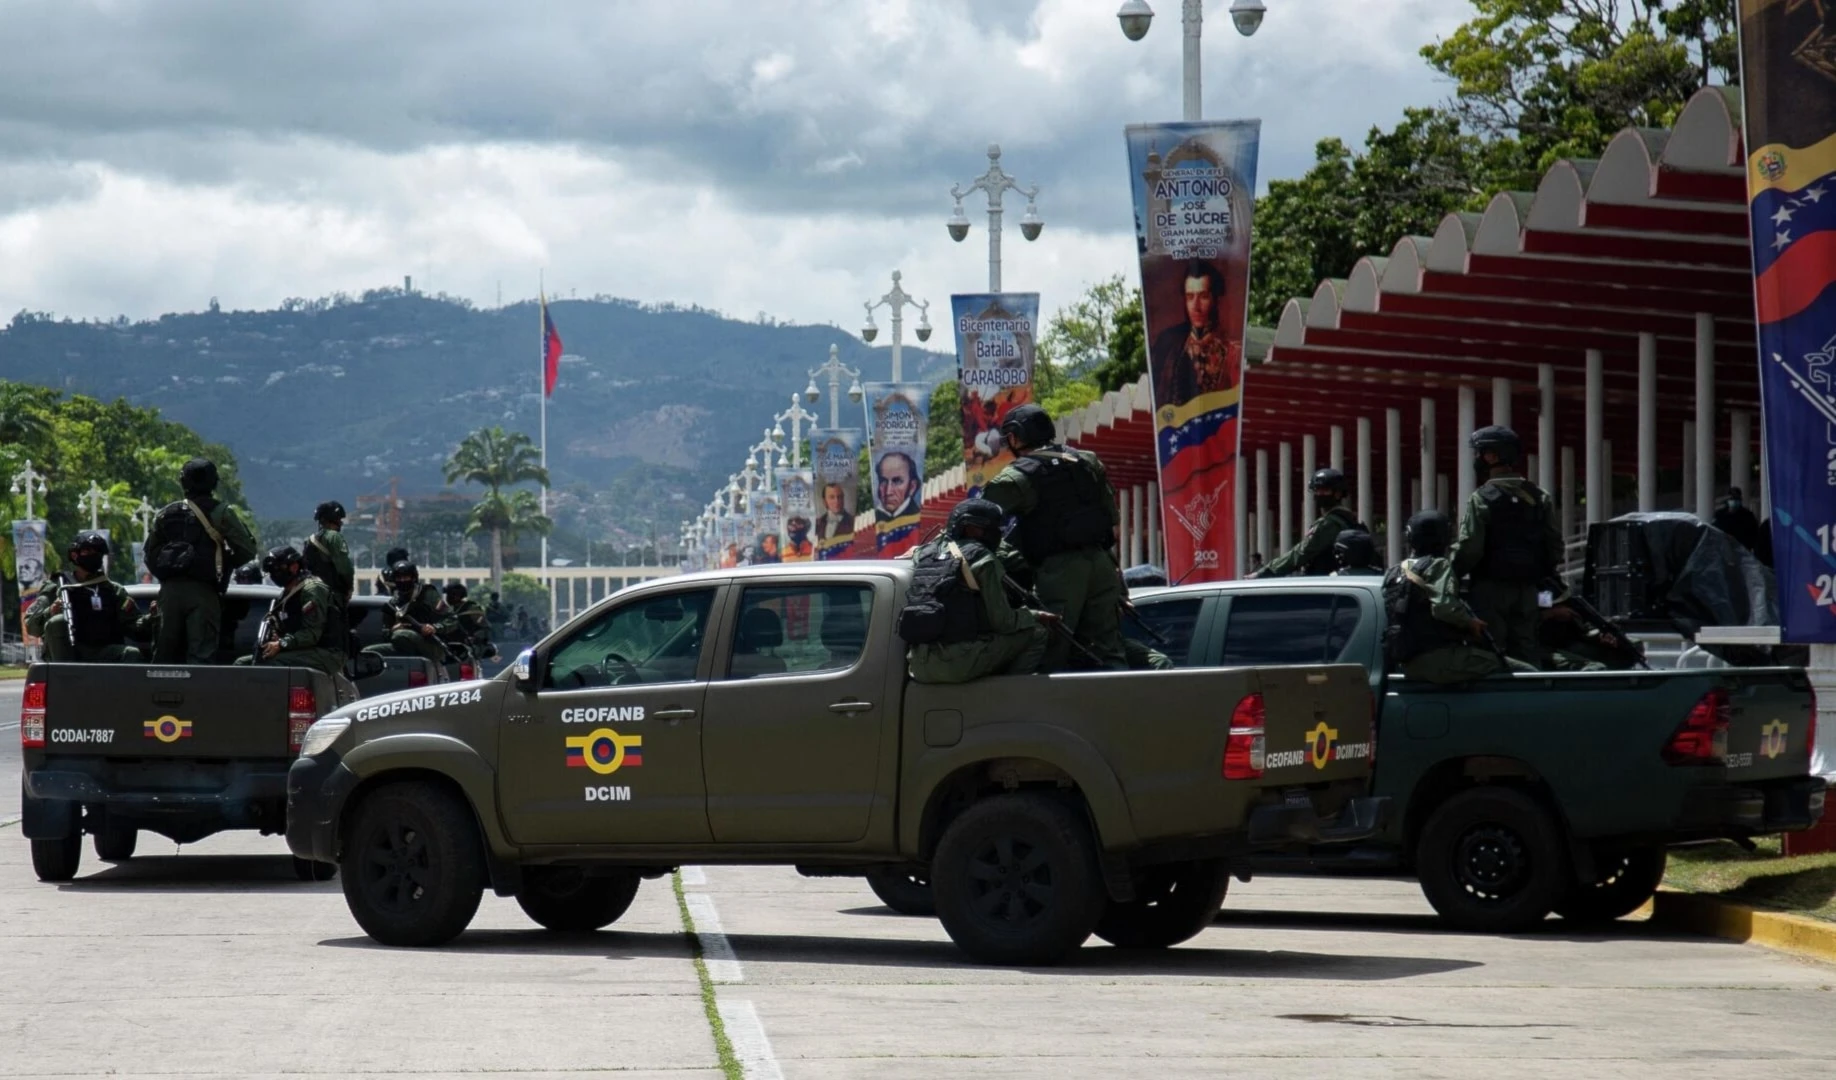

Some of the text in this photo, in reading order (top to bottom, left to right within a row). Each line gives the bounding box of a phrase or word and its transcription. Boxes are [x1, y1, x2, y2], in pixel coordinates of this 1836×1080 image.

[1156, 180, 1231, 198] ANTONIO
[1181, 199, 1206, 211] JOSÉ
[1157, 212, 1230, 226] DE SUCRE
[1161, 228, 1225, 237] GRAN MARISCAL
[1165, 238, 1222, 247] DE AYACUCHO
[1198, 248, 1217, 257] 1830
[960, 318, 1030, 332] Bicentenario
[977, 340, 1014, 357] Batalla
[964, 369, 1028, 385] CARABOBO
[356, 689, 482, 722] CEOFANB 7284
[561, 706, 645, 723] CEOFANB
[51, 729, 115, 743] CODAI-7887
[1266, 750, 1305, 768] CEOFANB
[585, 786, 631, 801] DCIM
